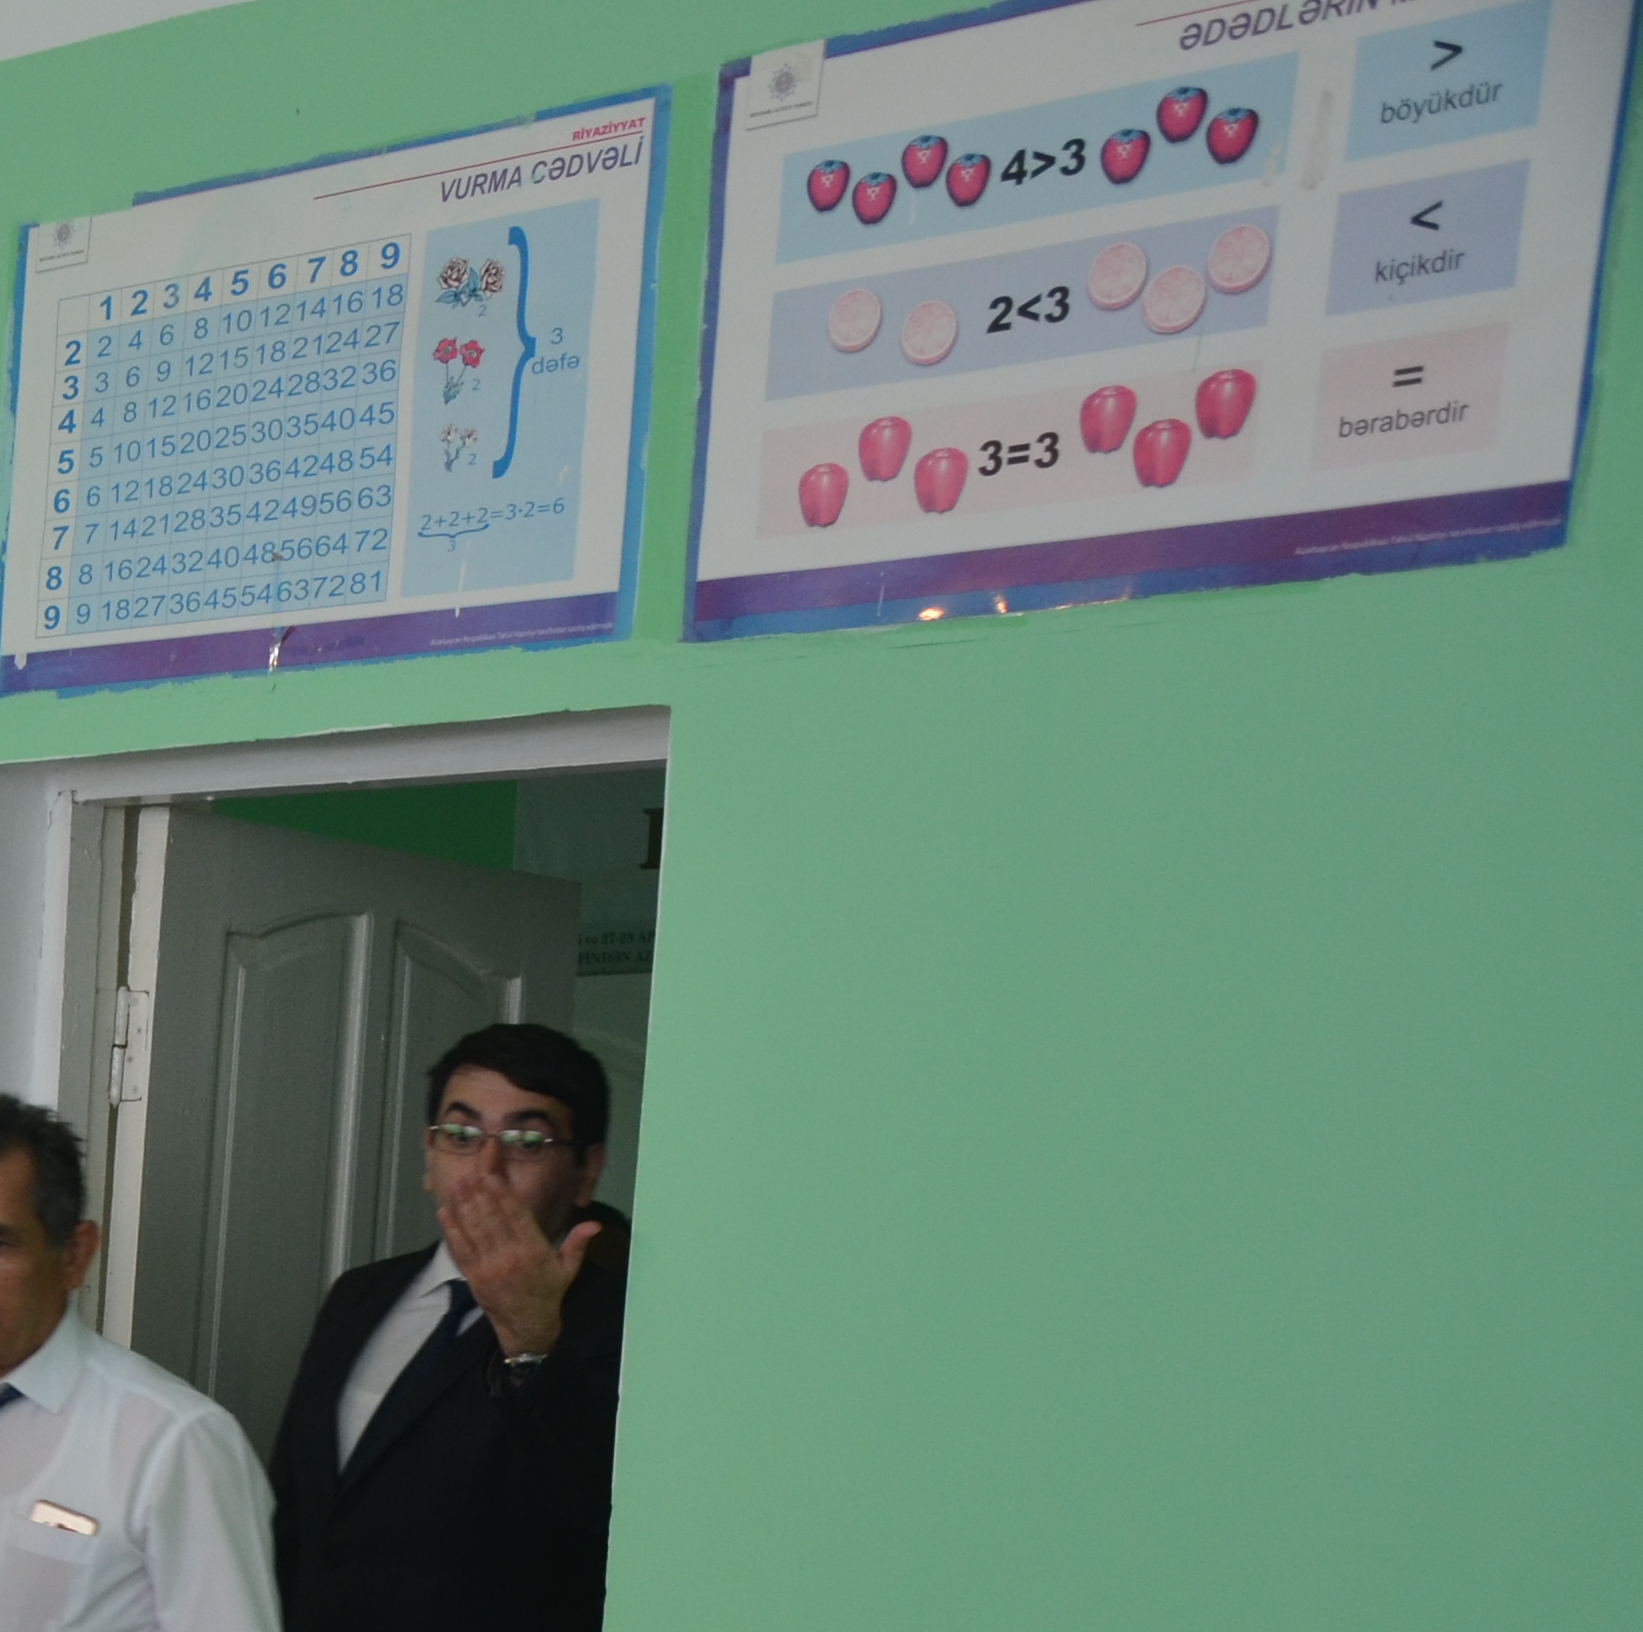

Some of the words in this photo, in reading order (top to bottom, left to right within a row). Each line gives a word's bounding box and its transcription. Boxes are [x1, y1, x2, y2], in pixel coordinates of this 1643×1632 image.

[1380, 81, 1505, 124] böyükdür
[572, 116, 646, 142] RİYAZİYYAT
[440, 165, 522, 203] VURMA
[531, 136, 645, 185] CƏDVƏLİ
[1000, 137, 1086, 186] 4>3
[100, 295, 112, 321] 1
[130, 289, 149, 316] 2
[163, 282, 180, 310] 3
[193, 276, 213, 302] 4
[230, 269, 250, 296] 5
[267, 263, 287, 290] 6
[308, 256, 327, 284] 7
[339, 249, 359, 277] 8
[381, 242, 401, 270] 9
[1374, 248, 1466, 286] kiçikdir
[64, 339, 82, 366] 2
[97, 335, 112, 359] 2
[128, 329, 143, 351] 4
[159, 323, 175, 346] 6
[193, 317, 209, 340] 8
[222, 309, 253, 334] 10
[260, 303, 291, 328] 12
[296, 296, 327, 322] 14
[332, 290, 364, 315] 16
[372, 283, 404, 309] 18
[477, 303, 488, 318] 2
[986, 285, 1070, 334] 2<3
[550, 326, 564, 345] 3
[62, 375, 79, 401] 3
[94, 371, 110, 394] 3
[125, 365, 141, 388] 6
[156, 360, 172, 383] 9
[185, 352, 214, 377] 12
[220, 346, 249, 371] 15
[256, 340, 286, 365] 18
[291, 333, 323, 360] 21
[324, 328, 360, 355] 24
[363, 320, 401, 348] 27
[471, 378, 481, 392] 2
[531, 351, 581, 374] dəfə
[58, 409, 77, 434] 4
[90, 407, 105, 427] 4
[122, 401, 138, 423] 8
[148, 394, 177, 418] 12
[185, 388, 212, 413] 16
[215, 382, 249, 409] 20
[251, 376, 284, 403] 24
[286, 370, 322, 397] 28
[322, 365, 358, 391] 32
[361, 358, 397, 385] 36
[1338, 400, 1470, 438] bərabərdir
[57, 449, 75, 475] 5
[89, 445, 104, 468] 5
[113, 439, 142, 464] 10
[146, 434, 177, 459] 15
[179, 429, 212, 455] 20
[214, 423, 248, 450] 25
[251, 418, 284, 444] 30
[285, 412, 320, 439] 35
[319, 407, 357, 432] 40
[358, 401, 396, 426] 45
[468, 452, 477, 466] 2
[978, 431, 1060, 477] 3=3
[53, 488, 71, 514] 6
[86, 485, 101, 508] 6
[111, 479, 140, 503] 12
[145, 475, 174, 499] 18
[176, 469, 209, 495] 24
[211, 464, 245, 490] 30
[248, 459, 282, 485] 36
[284, 454, 320, 479] 42
[319, 449, 355, 474] 48
[359, 443, 394, 470] 54
[53, 525, 70, 550] 7
[85, 522, 100, 545] 7
[110, 518, 137, 541] 14
[140, 513, 170, 538] 21
[173, 508, 206, 533] 28
[209, 503, 243, 528] 35
[245, 499, 280, 523] 42
[281, 494, 318, 519] 49
[318, 489, 353, 515] 56
[357, 484, 392, 510] 63
[45, 565, 63, 591] 8
[77, 563, 93, 586] 8
[104, 558, 133, 582] 16
[135, 554, 168, 579] 24
[171, 550, 204, 575] 32
[206, 545, 240, 569] 40
[242, 541, 278, 565] 48
[279, 537, 314, 562] 56
[314, 532, 349, 558] 64
[355, 527, 389, 553] 72
[44, 604, 61, 630] 9
[76, 603, 92, 625] 9
[102, 598, 131, 621] 18
[133, 594, 167, 619] 27
[169, 590, 201, 615] 36
[203, 586, 238, 610] 45
[240, 582, 274, 607] 54
[274, 578, 310, 603] 63
[312, 574, 346, 599] 72
[349, 570, 382, 595] 81
